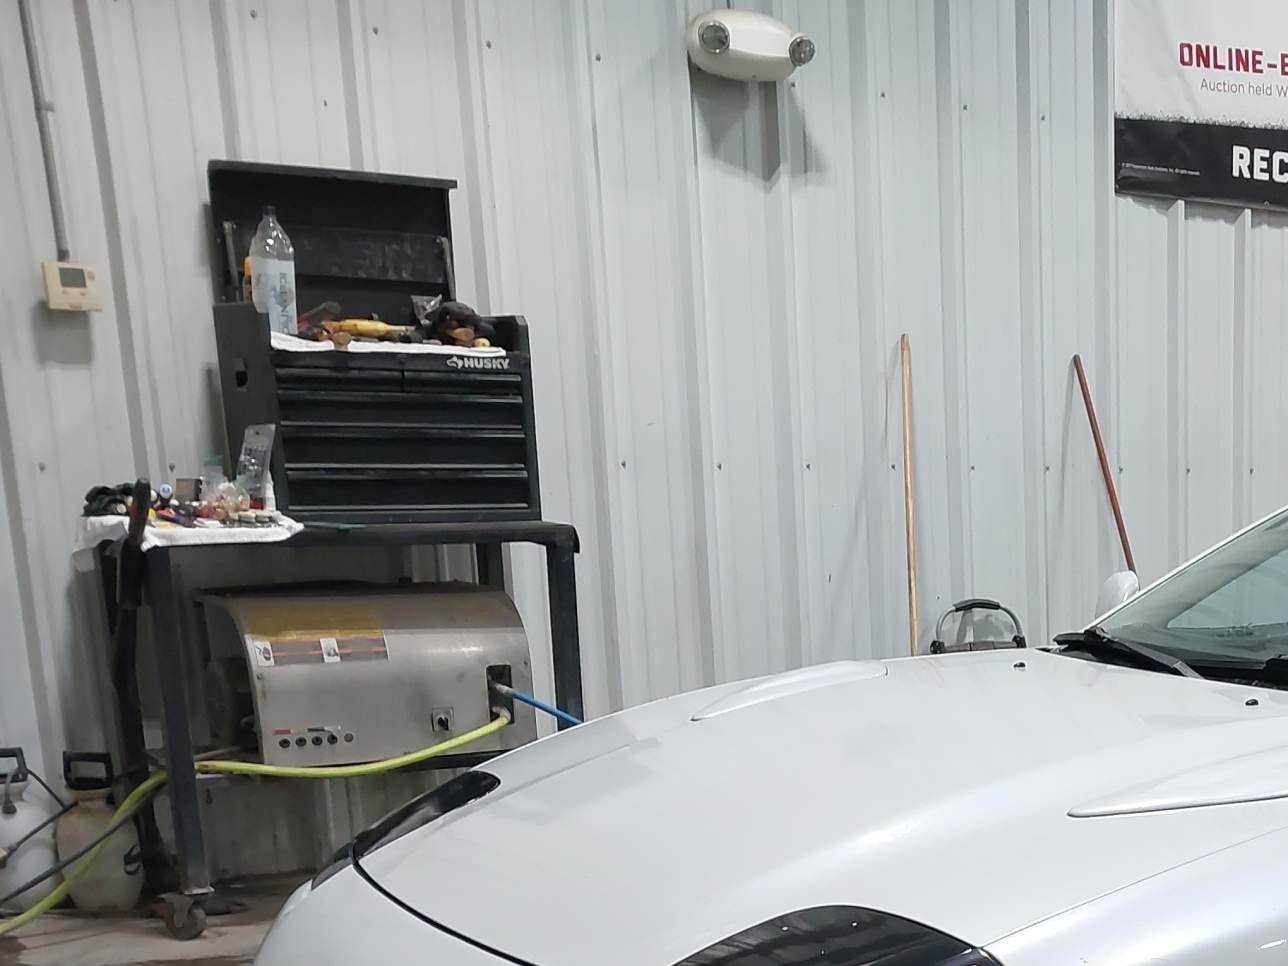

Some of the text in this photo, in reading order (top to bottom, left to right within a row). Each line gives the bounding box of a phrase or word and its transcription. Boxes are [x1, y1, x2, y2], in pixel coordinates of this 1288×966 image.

[1200, 78, 1245, 93] Auction
[1249, 82, 1273, 96] held
[463, 357, 510, 370] HUSKY
